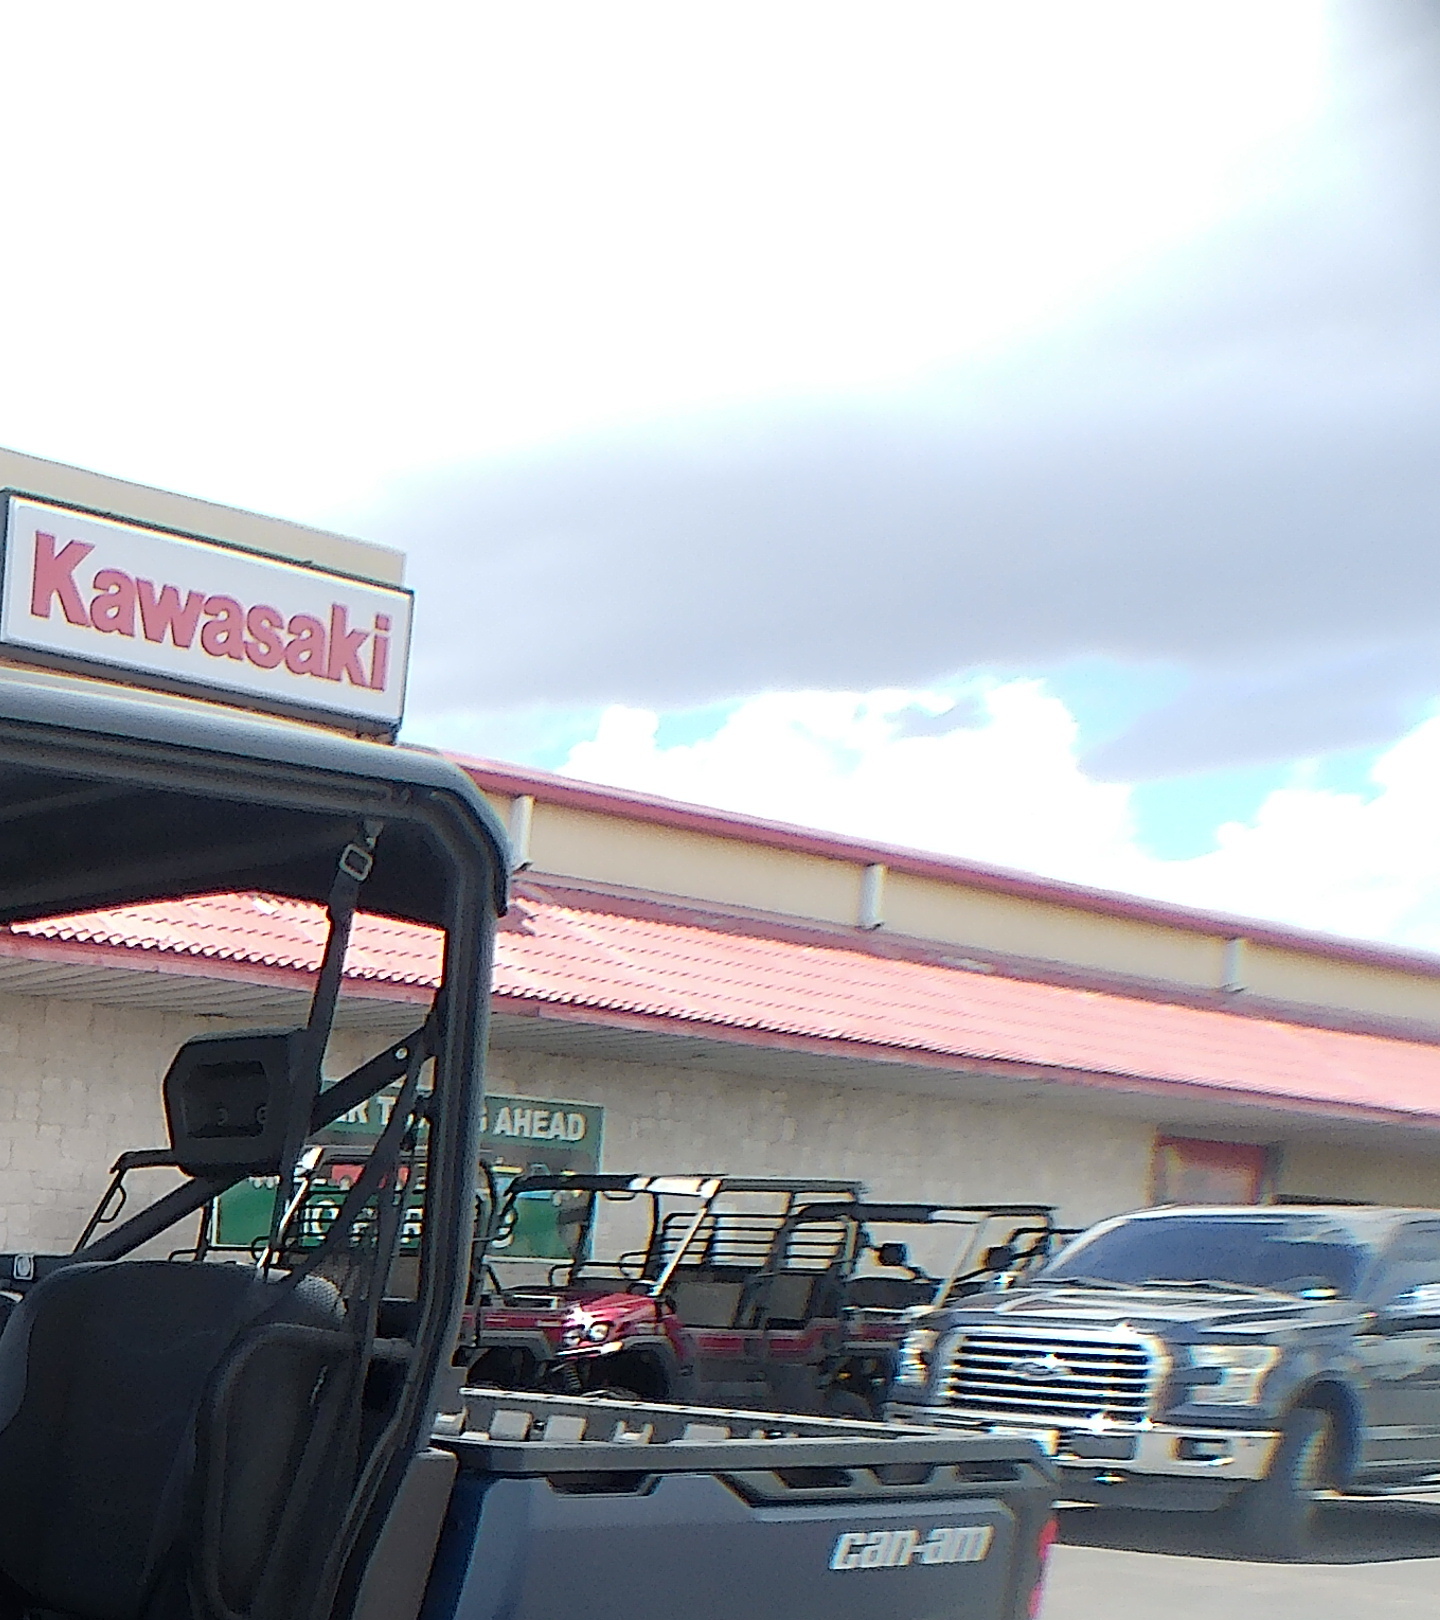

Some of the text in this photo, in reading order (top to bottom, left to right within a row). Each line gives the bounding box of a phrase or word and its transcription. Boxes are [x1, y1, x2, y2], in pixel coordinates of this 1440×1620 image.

[30, 529, 392, 692] Kawasaki
[493, 1106, 587, 1141] AHEAD
[829, 1523, 1005, 1570] can-am
